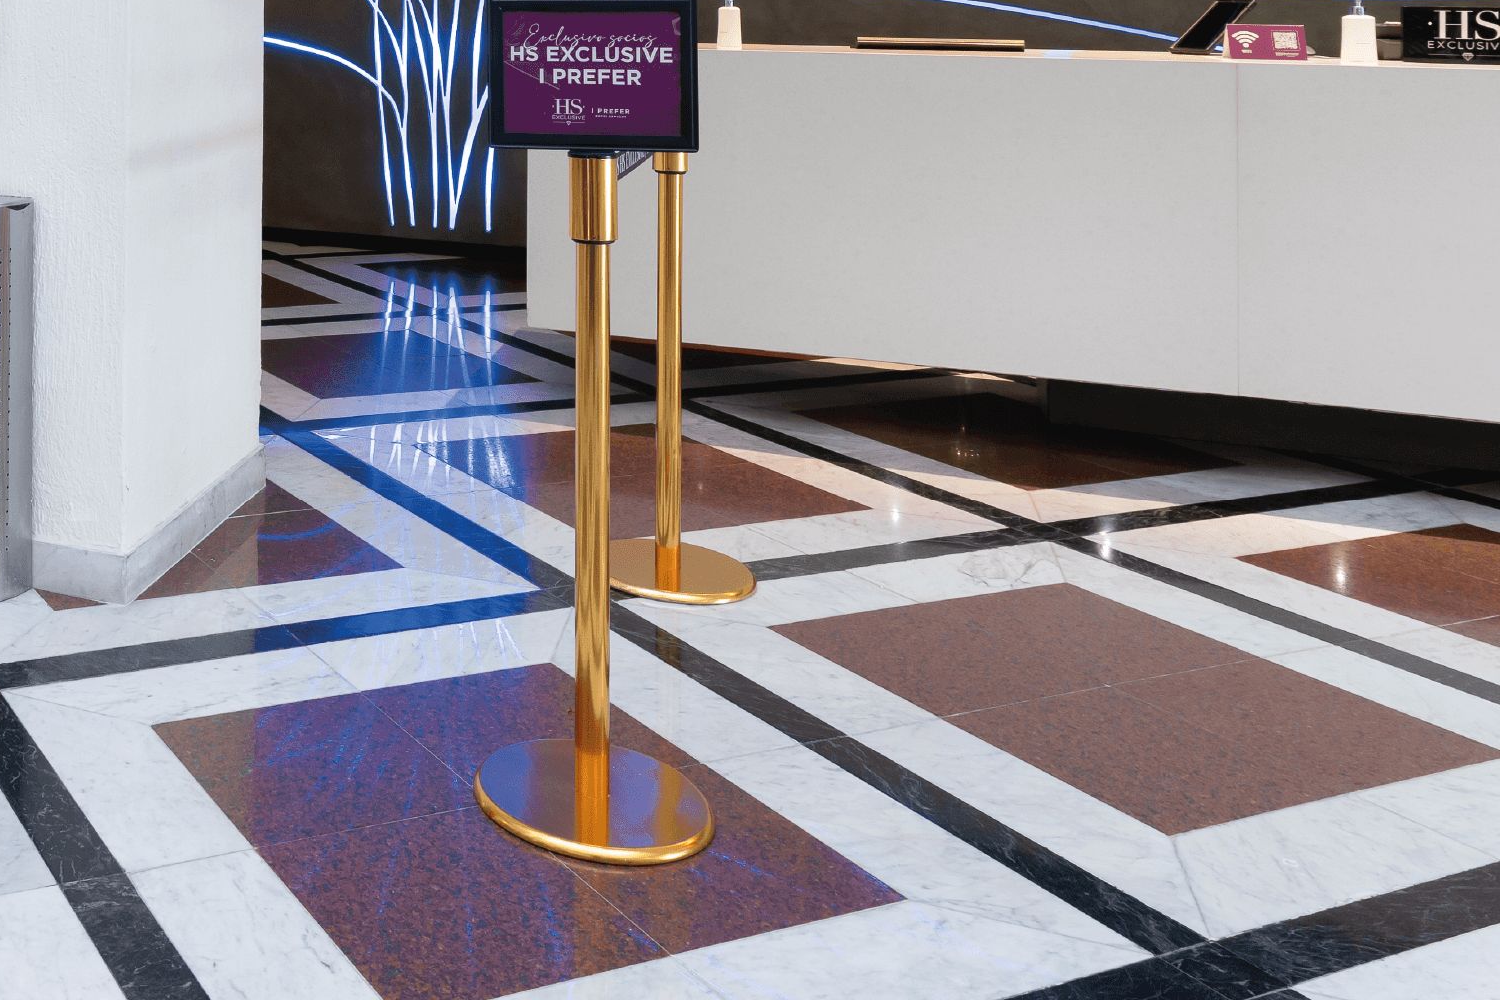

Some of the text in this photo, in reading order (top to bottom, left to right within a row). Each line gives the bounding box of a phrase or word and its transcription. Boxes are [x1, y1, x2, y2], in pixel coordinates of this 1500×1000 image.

[1432, 9, 1500, 41] HS
[523, 23, 658, 51] Exclusivo socios
[510, 45, 673, 64] HS EXCLUSIVE
[539, 68, 642, 86] I PREFER
[553, 98, 583, 115] HS
